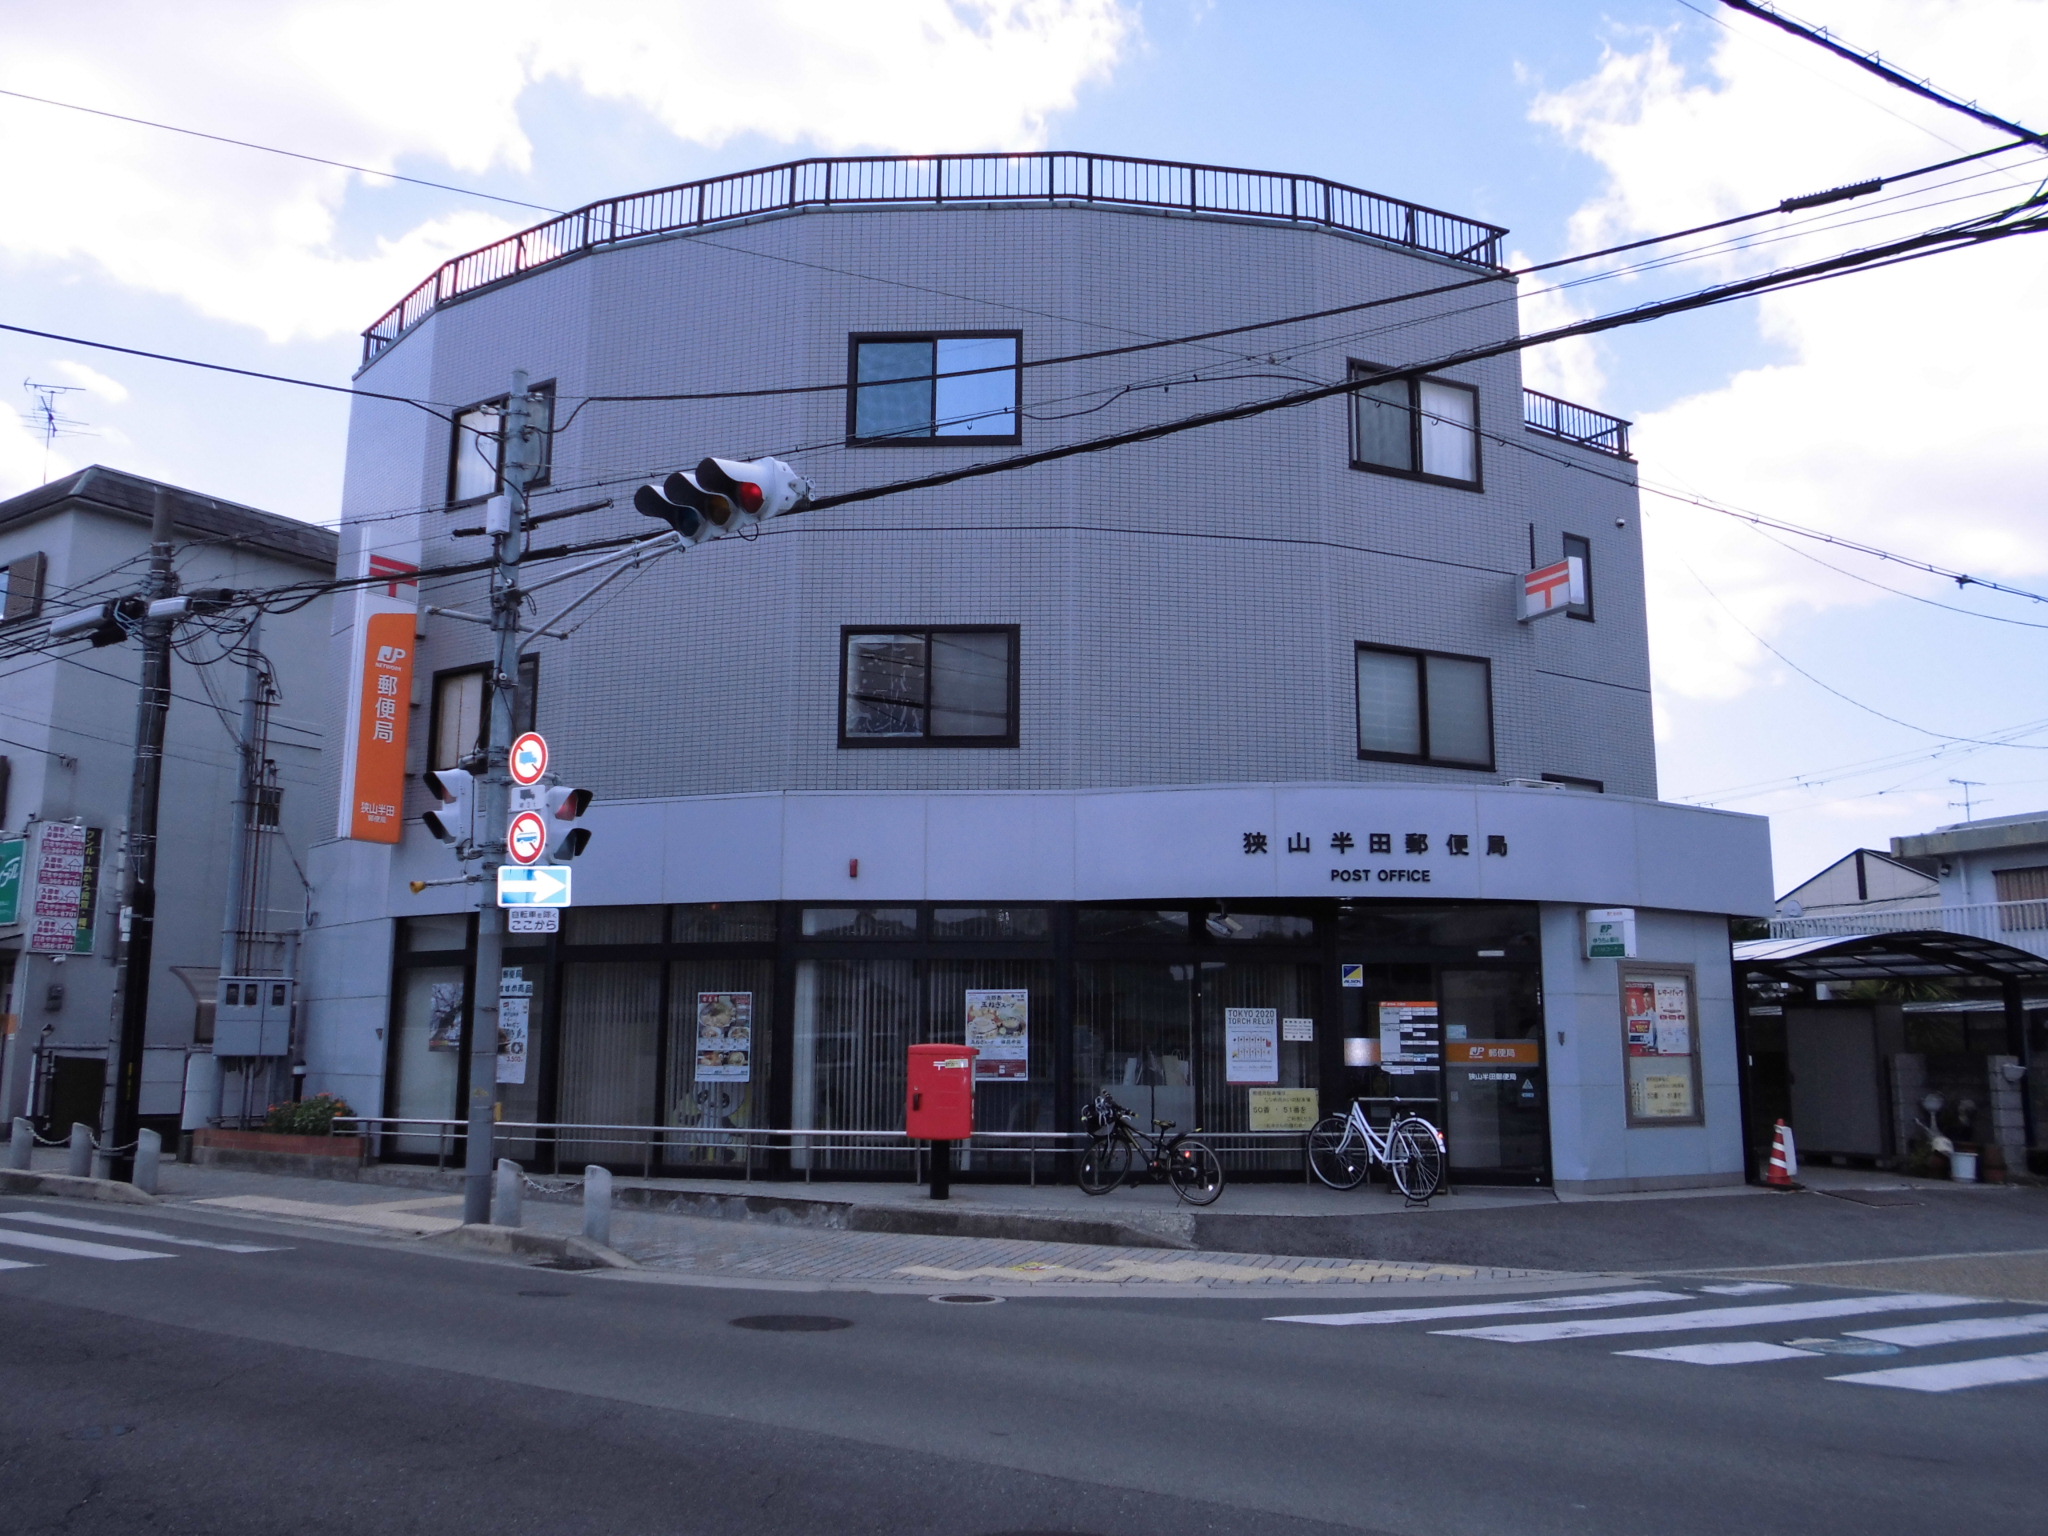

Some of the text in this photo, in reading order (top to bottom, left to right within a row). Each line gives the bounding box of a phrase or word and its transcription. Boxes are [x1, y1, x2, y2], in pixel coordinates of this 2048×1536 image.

[373, 674, 398, 744] 郵便局
[360, 801, 395, 817] 狭山半田
[1243, 831, 1509, 857] 狭山半田郵便局
[1331, 869, 1431, 883] POST OFFICE
[511, 911, 558, 919] 自転車を除く
[511, 920, 557, 931] ここから
[1228, 1009, 1275, 1018] TOKYO 2020
[1228, 1017, 1274, 1025] TORCH RELAY
[1468, 1073, 1517, 1081] 狭山半田郵便局
